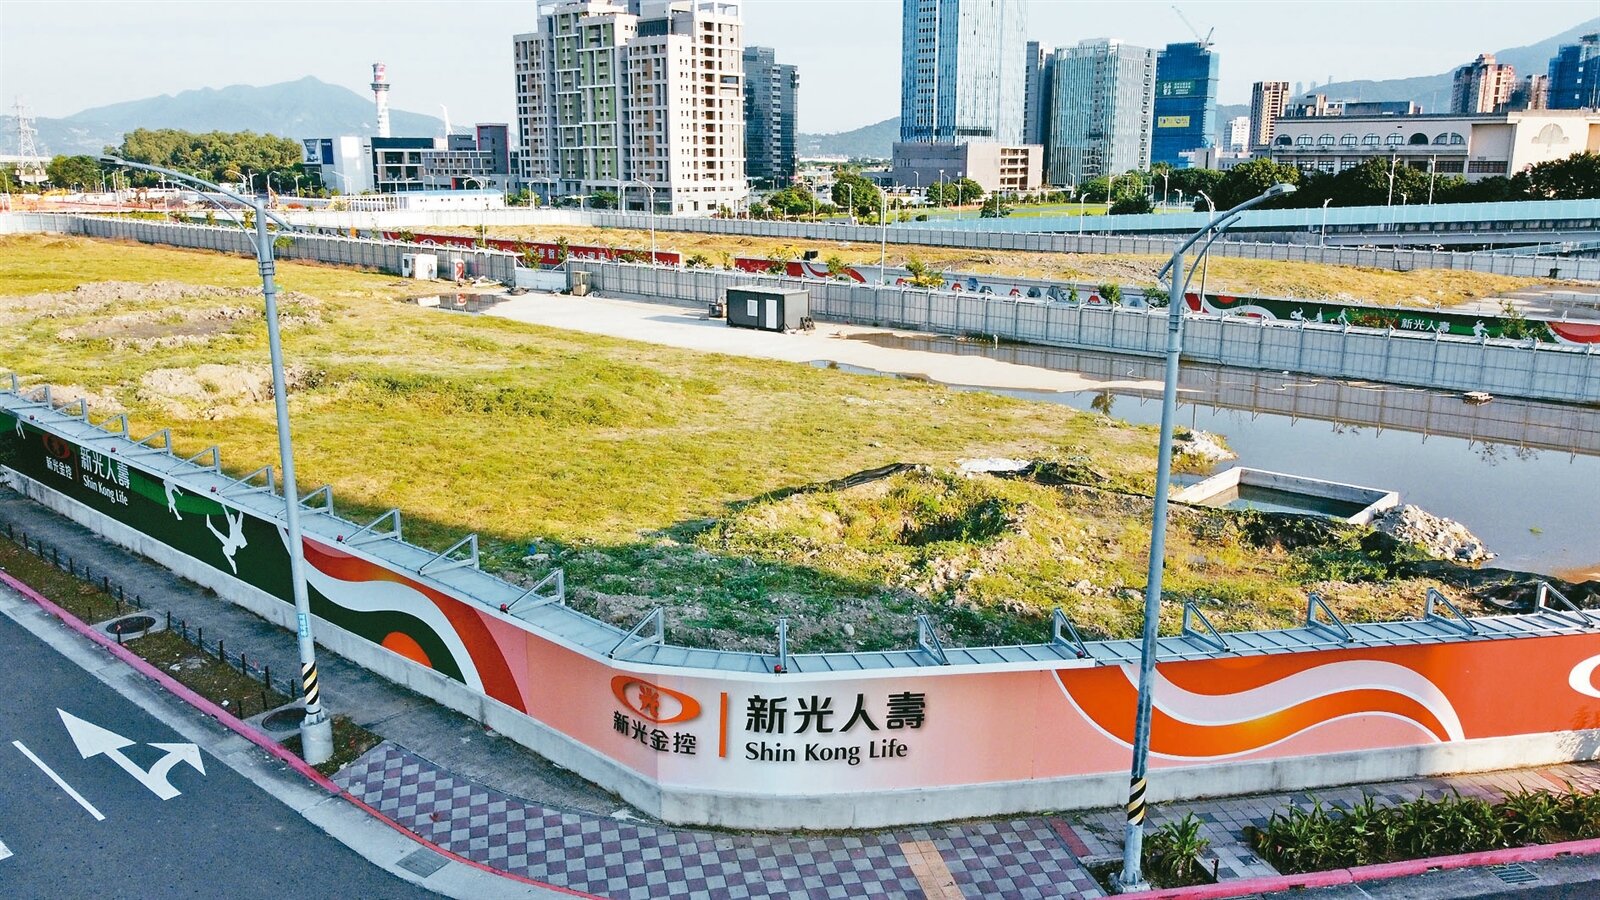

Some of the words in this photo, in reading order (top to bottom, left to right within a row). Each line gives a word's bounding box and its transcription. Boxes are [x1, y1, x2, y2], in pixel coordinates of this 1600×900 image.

[46, 456, 72, 479] 新光金控
[80, 446, 130, 489] 新光人壽
[83, 475, 97, 491] Shin
[98, 482, 116, 504] Kong
[115, 490, 129, 506] Life
[745, 691, 926, 734] 新光人壽
[613, 710, 697, 755] 新光金控
[745, 741, 796, 762] Shin
[805, 742, 861, 766] Kong
[869, 738, 908, 759] Life
